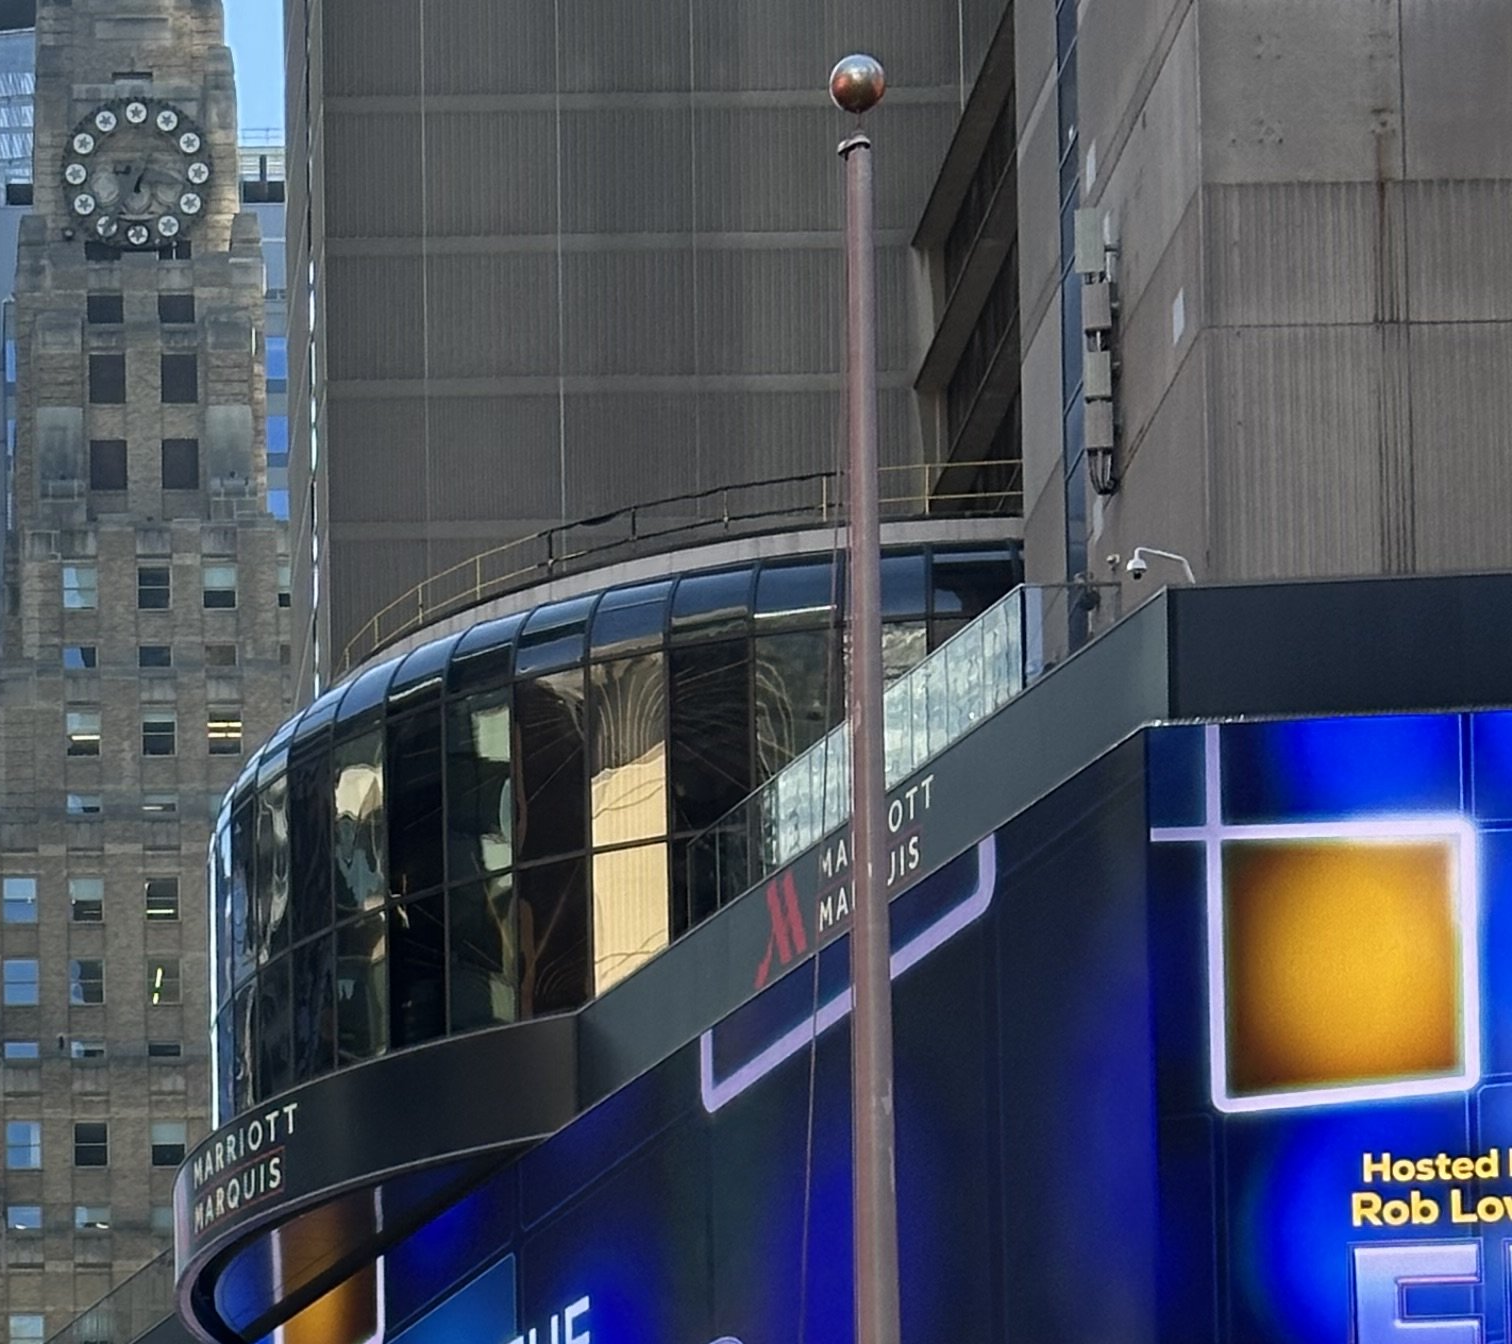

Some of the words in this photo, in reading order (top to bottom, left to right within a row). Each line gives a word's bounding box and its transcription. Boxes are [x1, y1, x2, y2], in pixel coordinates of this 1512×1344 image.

[193, 1102, 298, 1190] MARRIOTT
[1362, 1148, 1500, 1183] Hosted
[193, 1156, 282, 1234] MARQUIS
[1351, 1190, 1440, 1227] Rob
